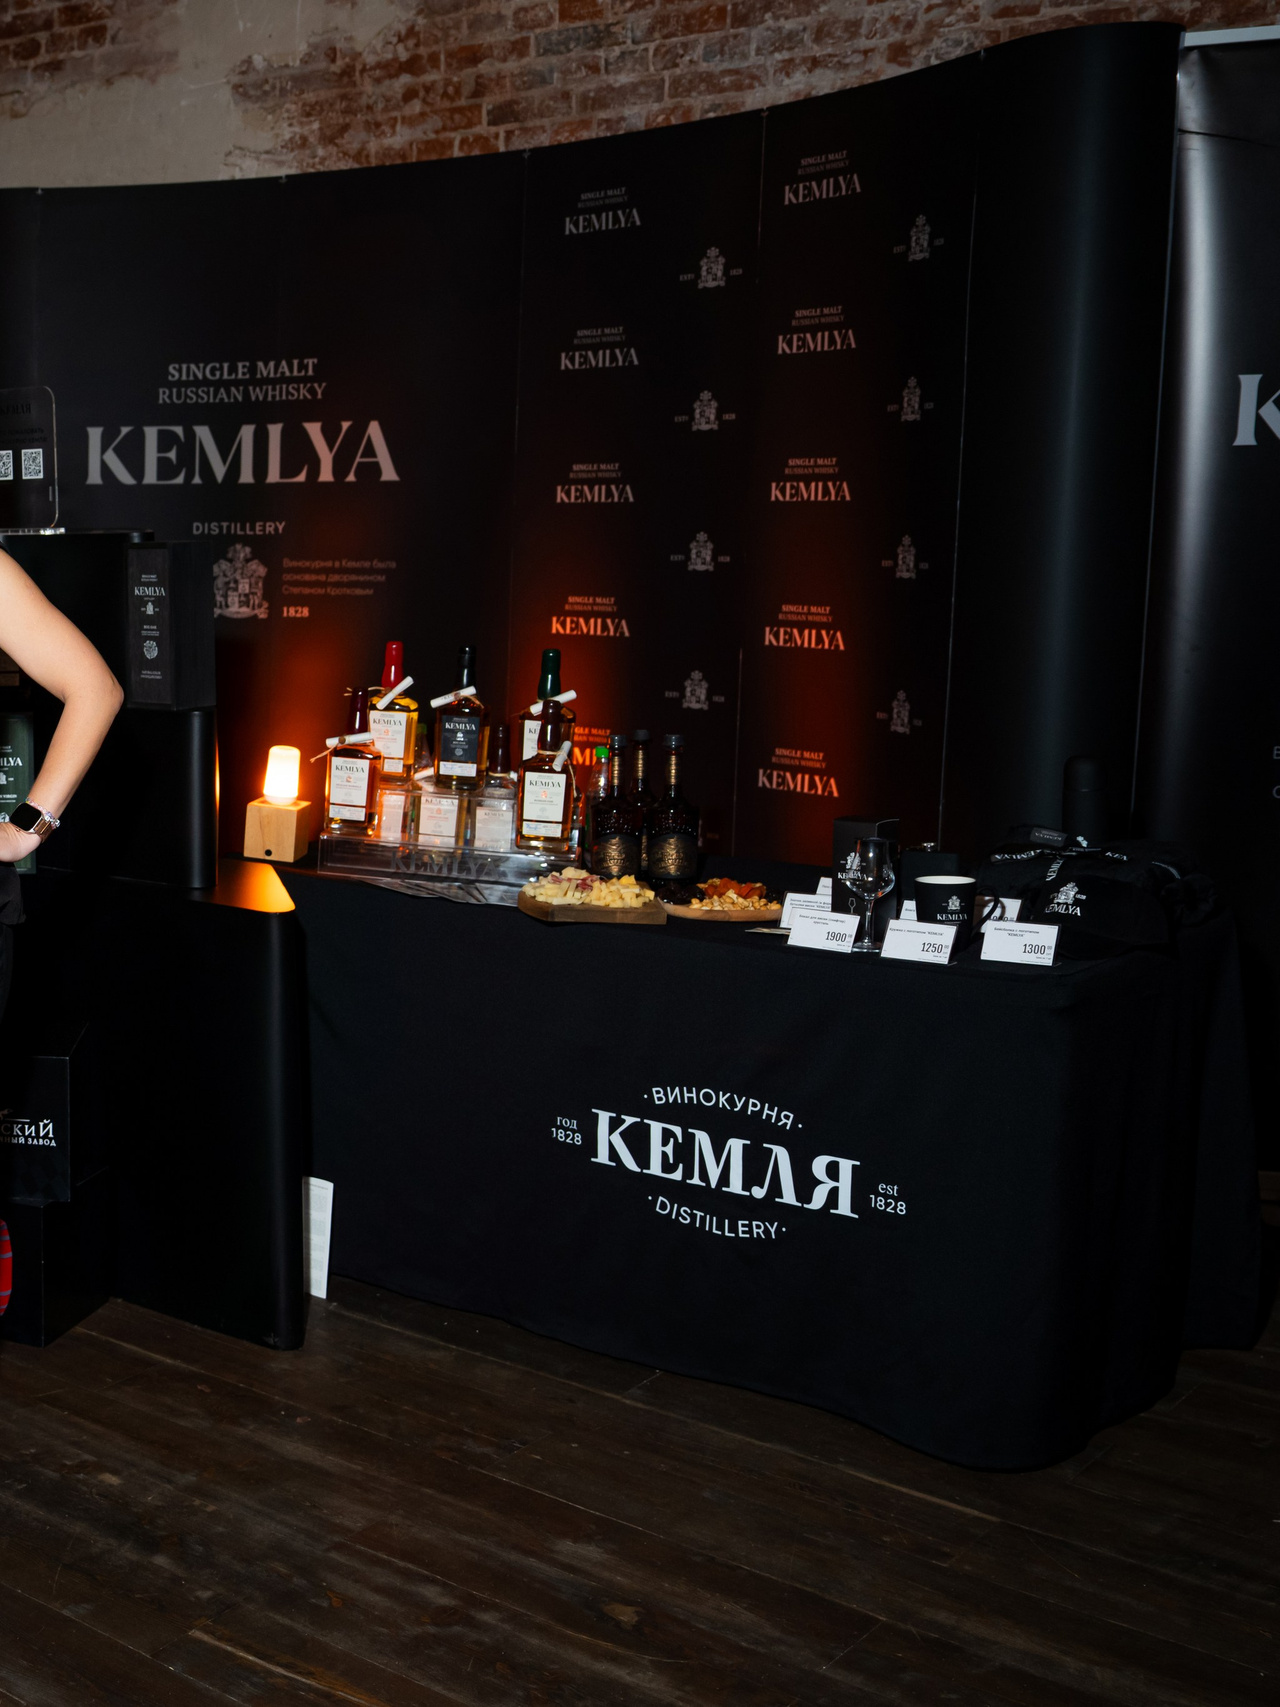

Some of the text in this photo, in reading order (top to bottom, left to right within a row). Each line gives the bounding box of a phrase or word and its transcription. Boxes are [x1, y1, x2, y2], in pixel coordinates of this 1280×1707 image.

[800, 149, 848, 166] SINGLE MALT
[580, 186, 627, 200] SINGLE MALT
[784, 172, 862, 206] KEMLYA
[564, 207, 642, 236] KEMLYA
[794, 305, 843, 318] SINGLE MALT
[576, 326, 624, 337] SINGLE MALT
[777, 328, 857, 355] KEMLYA
[560, 347, 639, 371] KEMLYA
[168, 358, 317, 381] SINGLE MALT
[158, 382, 327, 404] RUSSIAN WHISKY
[85, 420, 400, 485] KEMLYA
[572, 462, 620, 471] SINGLE MALT
[788, 457, 838, 466] SINGLE MALT
[556, 484, 635, 503] KEMLYA
[770, 480, 851, 502] KEMLYA
[193, 521, 286, 535] DISTILLERY
[283, 558, 333, 569] Винокурня
[134, 586, 165, 596] KEMLYA
[595, 596, 615, 604] MALT
[282, 606, 309, 618] 1828
[781, 604, 831, 614] SINGLE MALT
[551, 616, 631, 637] KEMLYA
[764, 626, 845, 651] KEMLYA
[372, 717, 403, 727] KEMLYA
[445, 722, 476, 731] KEMLYA
[774, 747, 824, 760] SINGLE MALT
[335, 764, 365, 773] KEMLYA
[529, 780, 561, 788] KEMLYA
[757, 768, 839, 798] KEMLYA
[390, 850, 501, 880] KEMLYA
[936, 913, 968, 921] KEMLYA
[825, 931, 847, 943] 1900
[921, 942, 944, 954] 1250
[1022, 943, 1046, 955] 1300
[652, 1086, 795, 1130] ВИНОКУРНЯ
[556, 1114, 578, 1130] год
[27, 1137, 57, 1147] ЗАВОД
[551, 1127, 582, 1145] 1828
[590, 1108, 861, 1219] КЕМЛЯ
[878, 1180, 899, 1197] est
[869, 1194, 907, 1215] 1828
[655, 1195, 779, 1240] DISTILLERY
